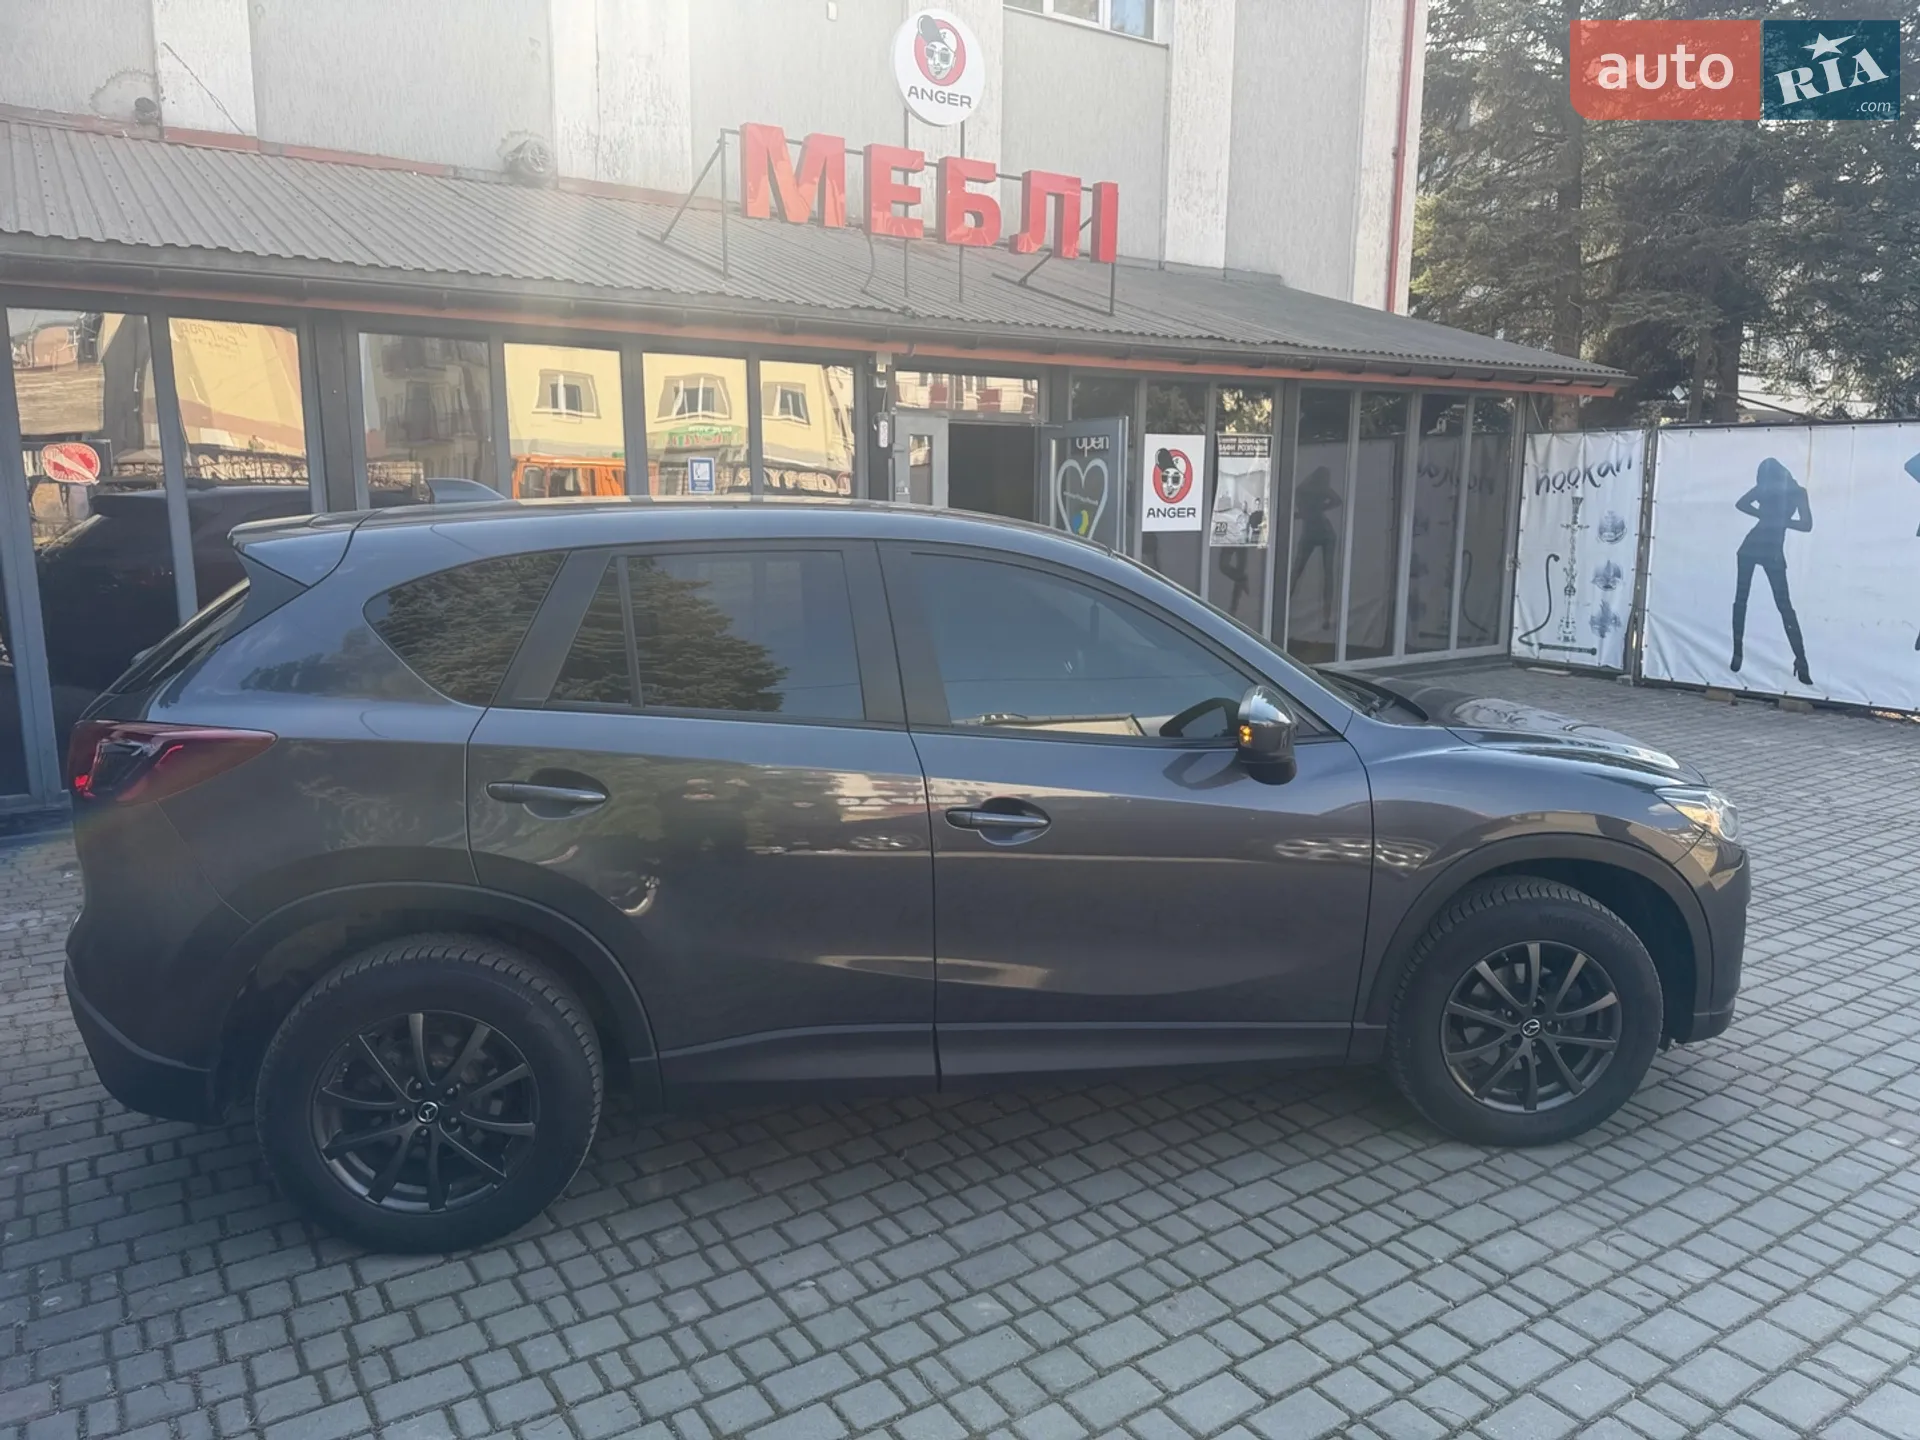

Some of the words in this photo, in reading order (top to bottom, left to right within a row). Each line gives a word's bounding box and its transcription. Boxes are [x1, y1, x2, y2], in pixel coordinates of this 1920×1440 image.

[907, 85, 973, 109] ANGER
[740, 122, 1118, 264] МЕБЛІ
[1146, 506, 1197, 519] ANGER
